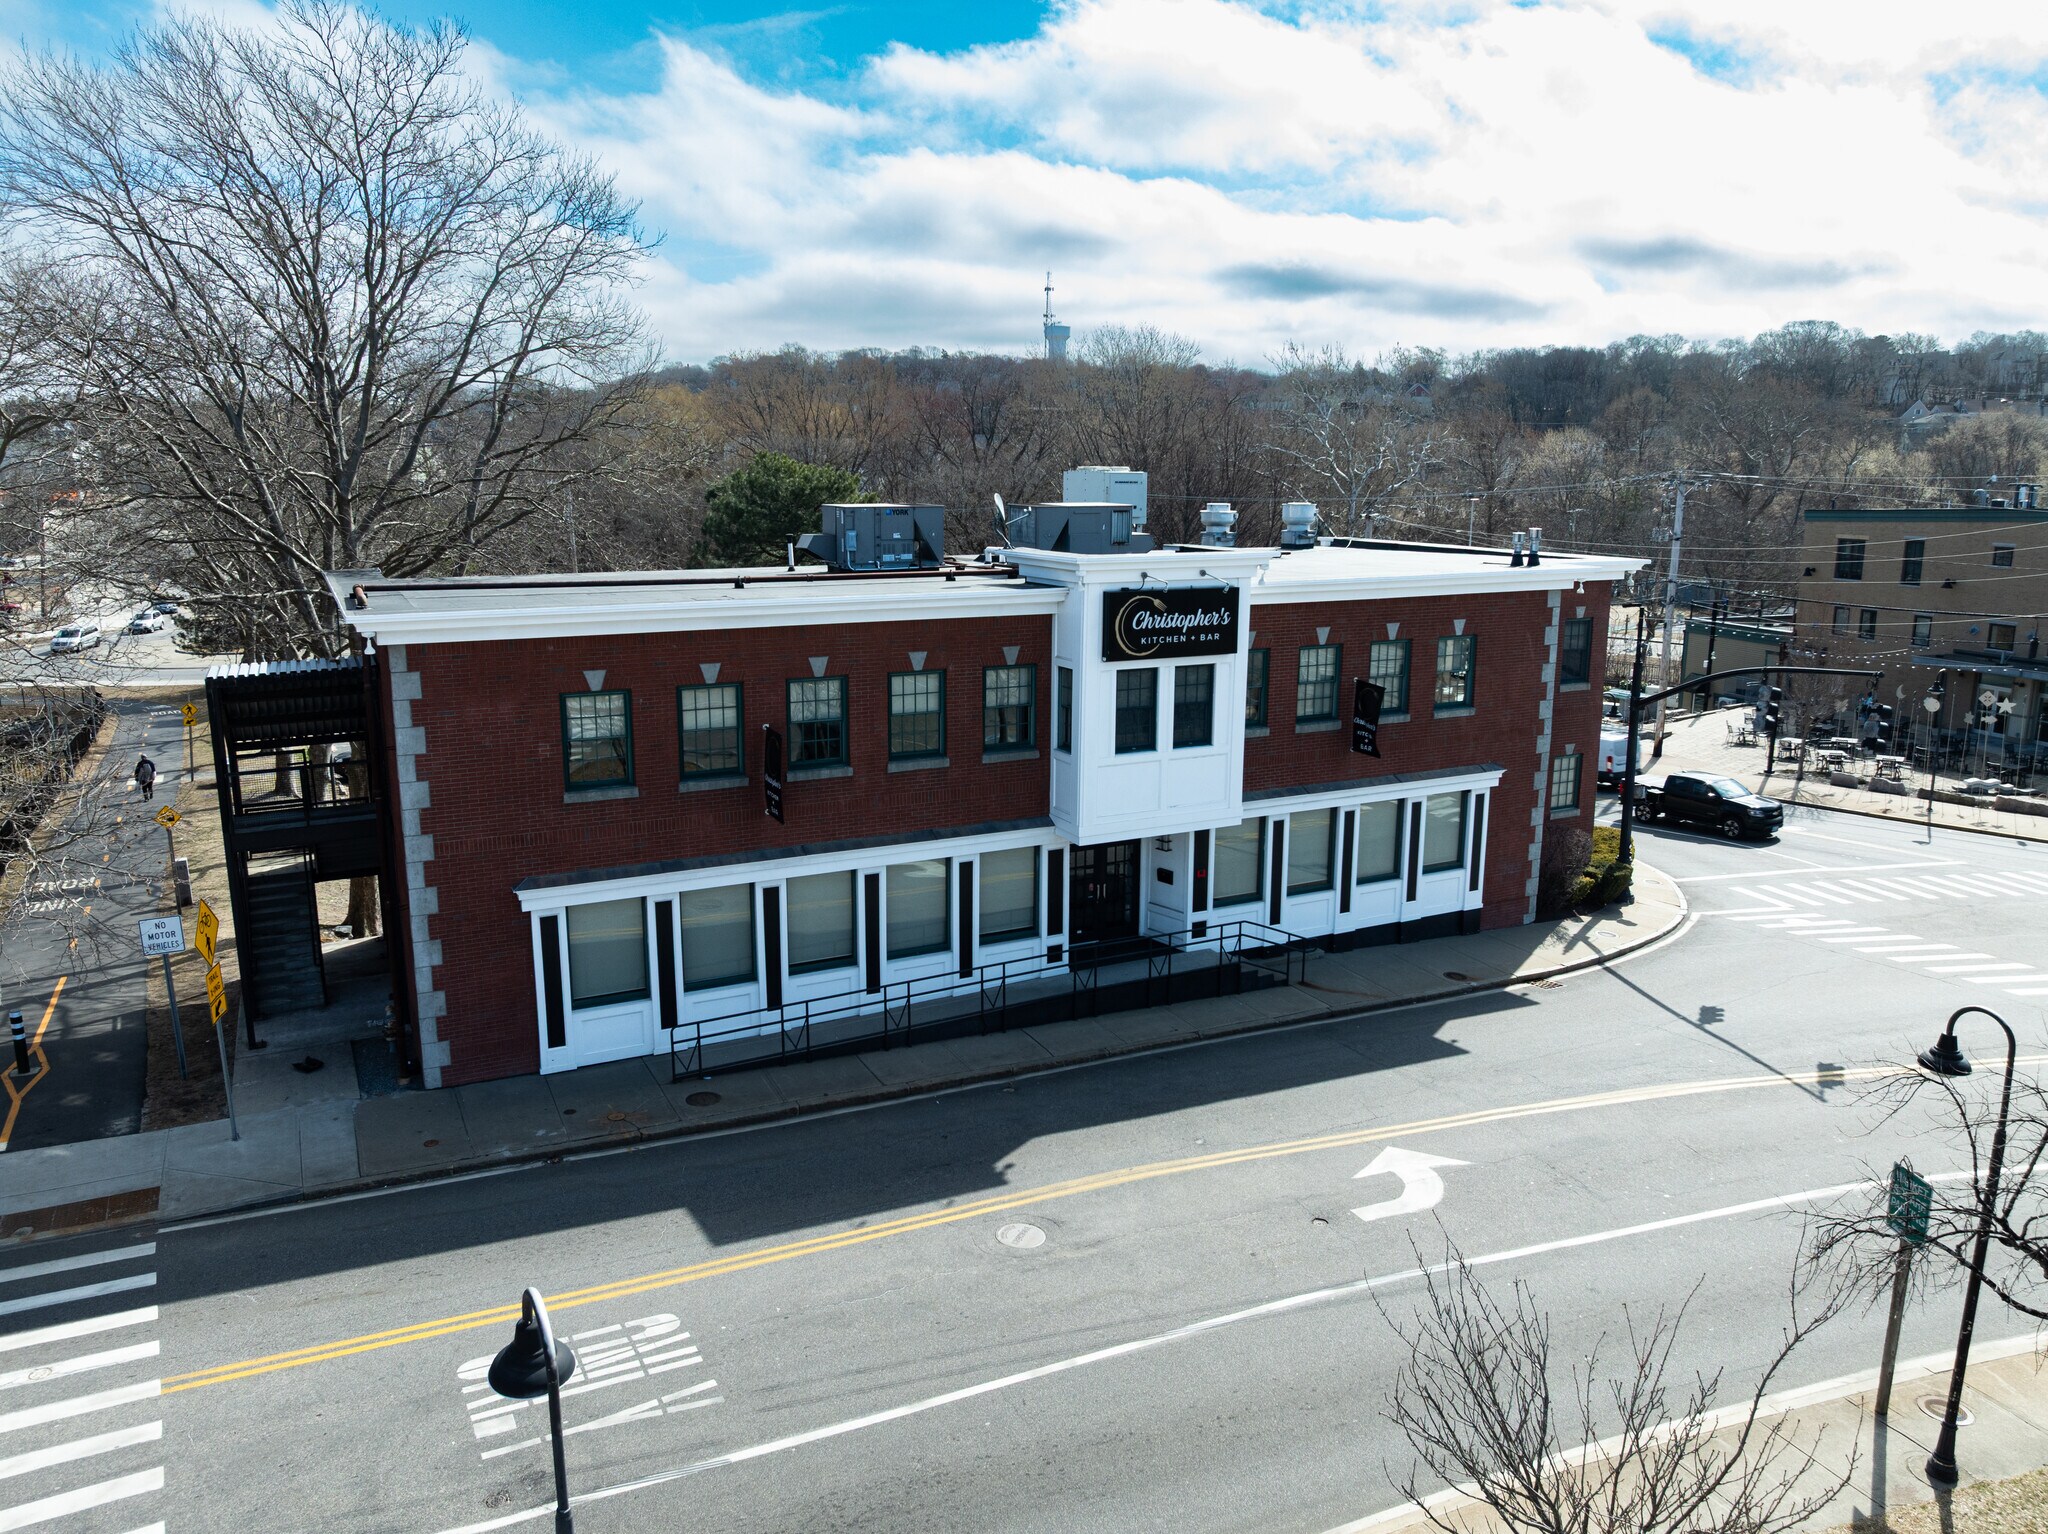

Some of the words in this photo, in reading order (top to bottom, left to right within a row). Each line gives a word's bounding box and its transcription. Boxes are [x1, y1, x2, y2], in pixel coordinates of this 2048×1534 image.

[892, 508, 909, 516] YORK
[1132, 607, 1232, 633] Christopher's
[1140, 634, 1187, 645] KITCHEN
[1200, 633, 1220, 642] BAR
[154, 920, 167, 930] NO
[147, 930, 177, 941] MOTOR
[147, 940, 180, 951] VEHICLES
